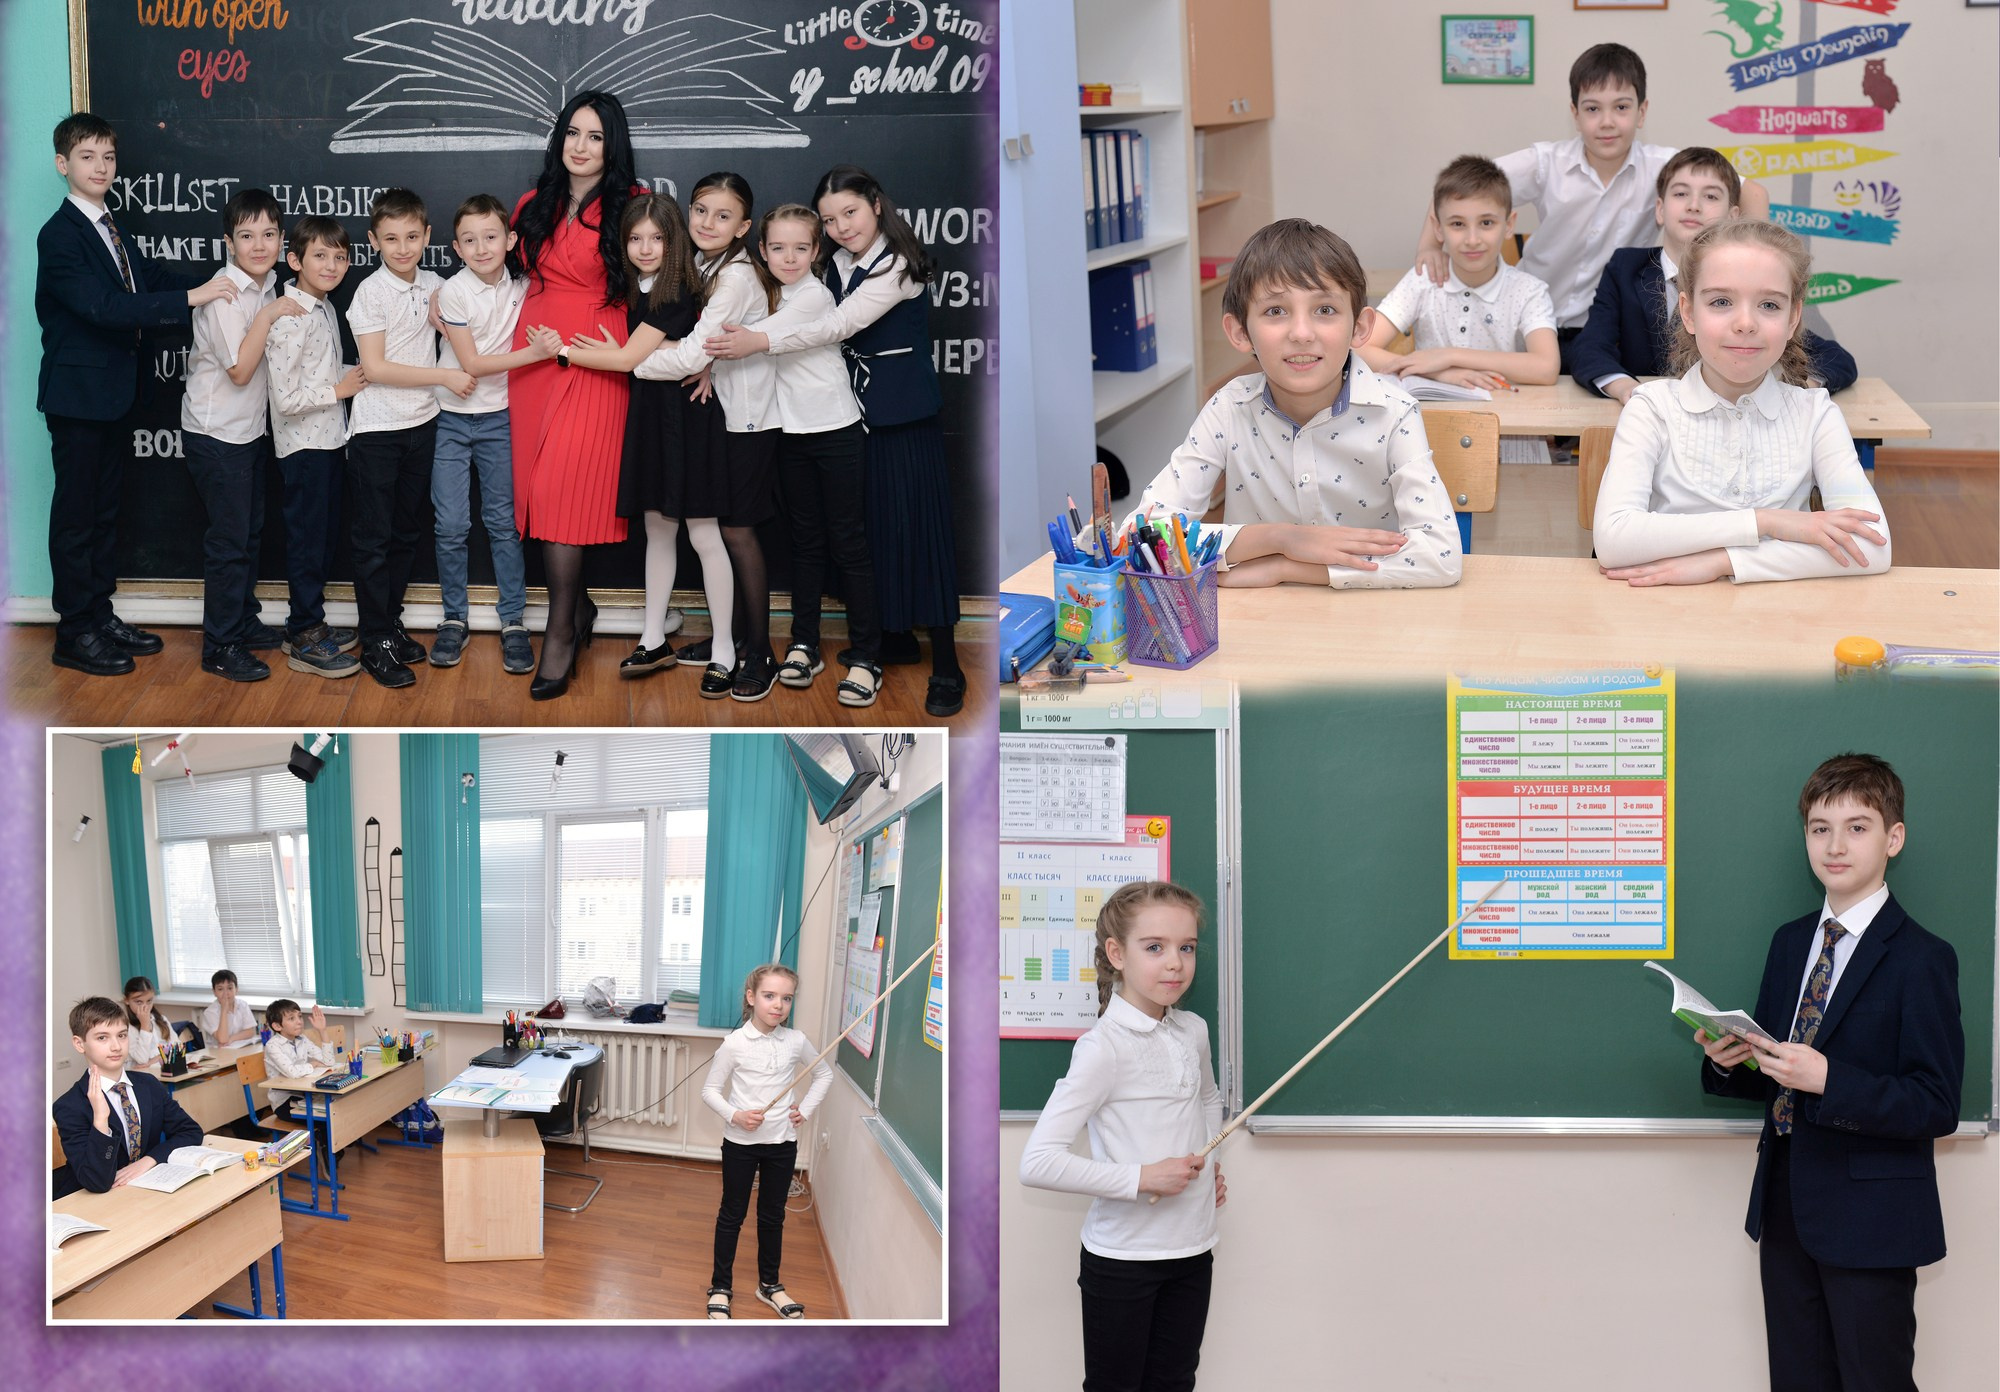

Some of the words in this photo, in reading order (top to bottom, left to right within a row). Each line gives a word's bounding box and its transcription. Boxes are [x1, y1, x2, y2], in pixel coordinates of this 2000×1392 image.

[212, 0, 289, 45] open
[784, 6, 852, 45] Little
[933, 3, 996, 45] time
[178, 49, 251, 98] eyes
[1759, 108, 1848, 133] Hogwarts
[1766, 146, 1856, 172] PANEM
[110, 173, 239, 213] SKILLSET
[269, 184, 402, 217] НАВЫК
[131, 234, 207, 261] HAKE
[1542, 674, 1588, 685] числам
[1591, 674, 1600, 684] и
[1602, 674, 1646, 686] родам
[1505, 700, 1579, 709] НАСТОЯЩЕЕ
[1583, 700, 1622, 709] ВРЕМЯ
[1045, 714, 1061, 723] 1000
[1513, 785, 1569, 795] БУДУЩЕЕ
[1572, 785, 1611, 793] ВРЕМЯ
[1007, 872, 1033, 880] КЛАСС
[1035, 873, 1061, 881] ТЫСЯЧ
[1086, 874, 1112, 882] КЛАСС
[1504, 870, 1581, 879] ПРОШЕДШЕЕ
[1584, 869, 1623, 878] ВРЕМЯ
[1527, 883, 1560, 891] мужской
[1575, 883, 1607, 891] женский
[1623, 883, 1654, 891] средний
